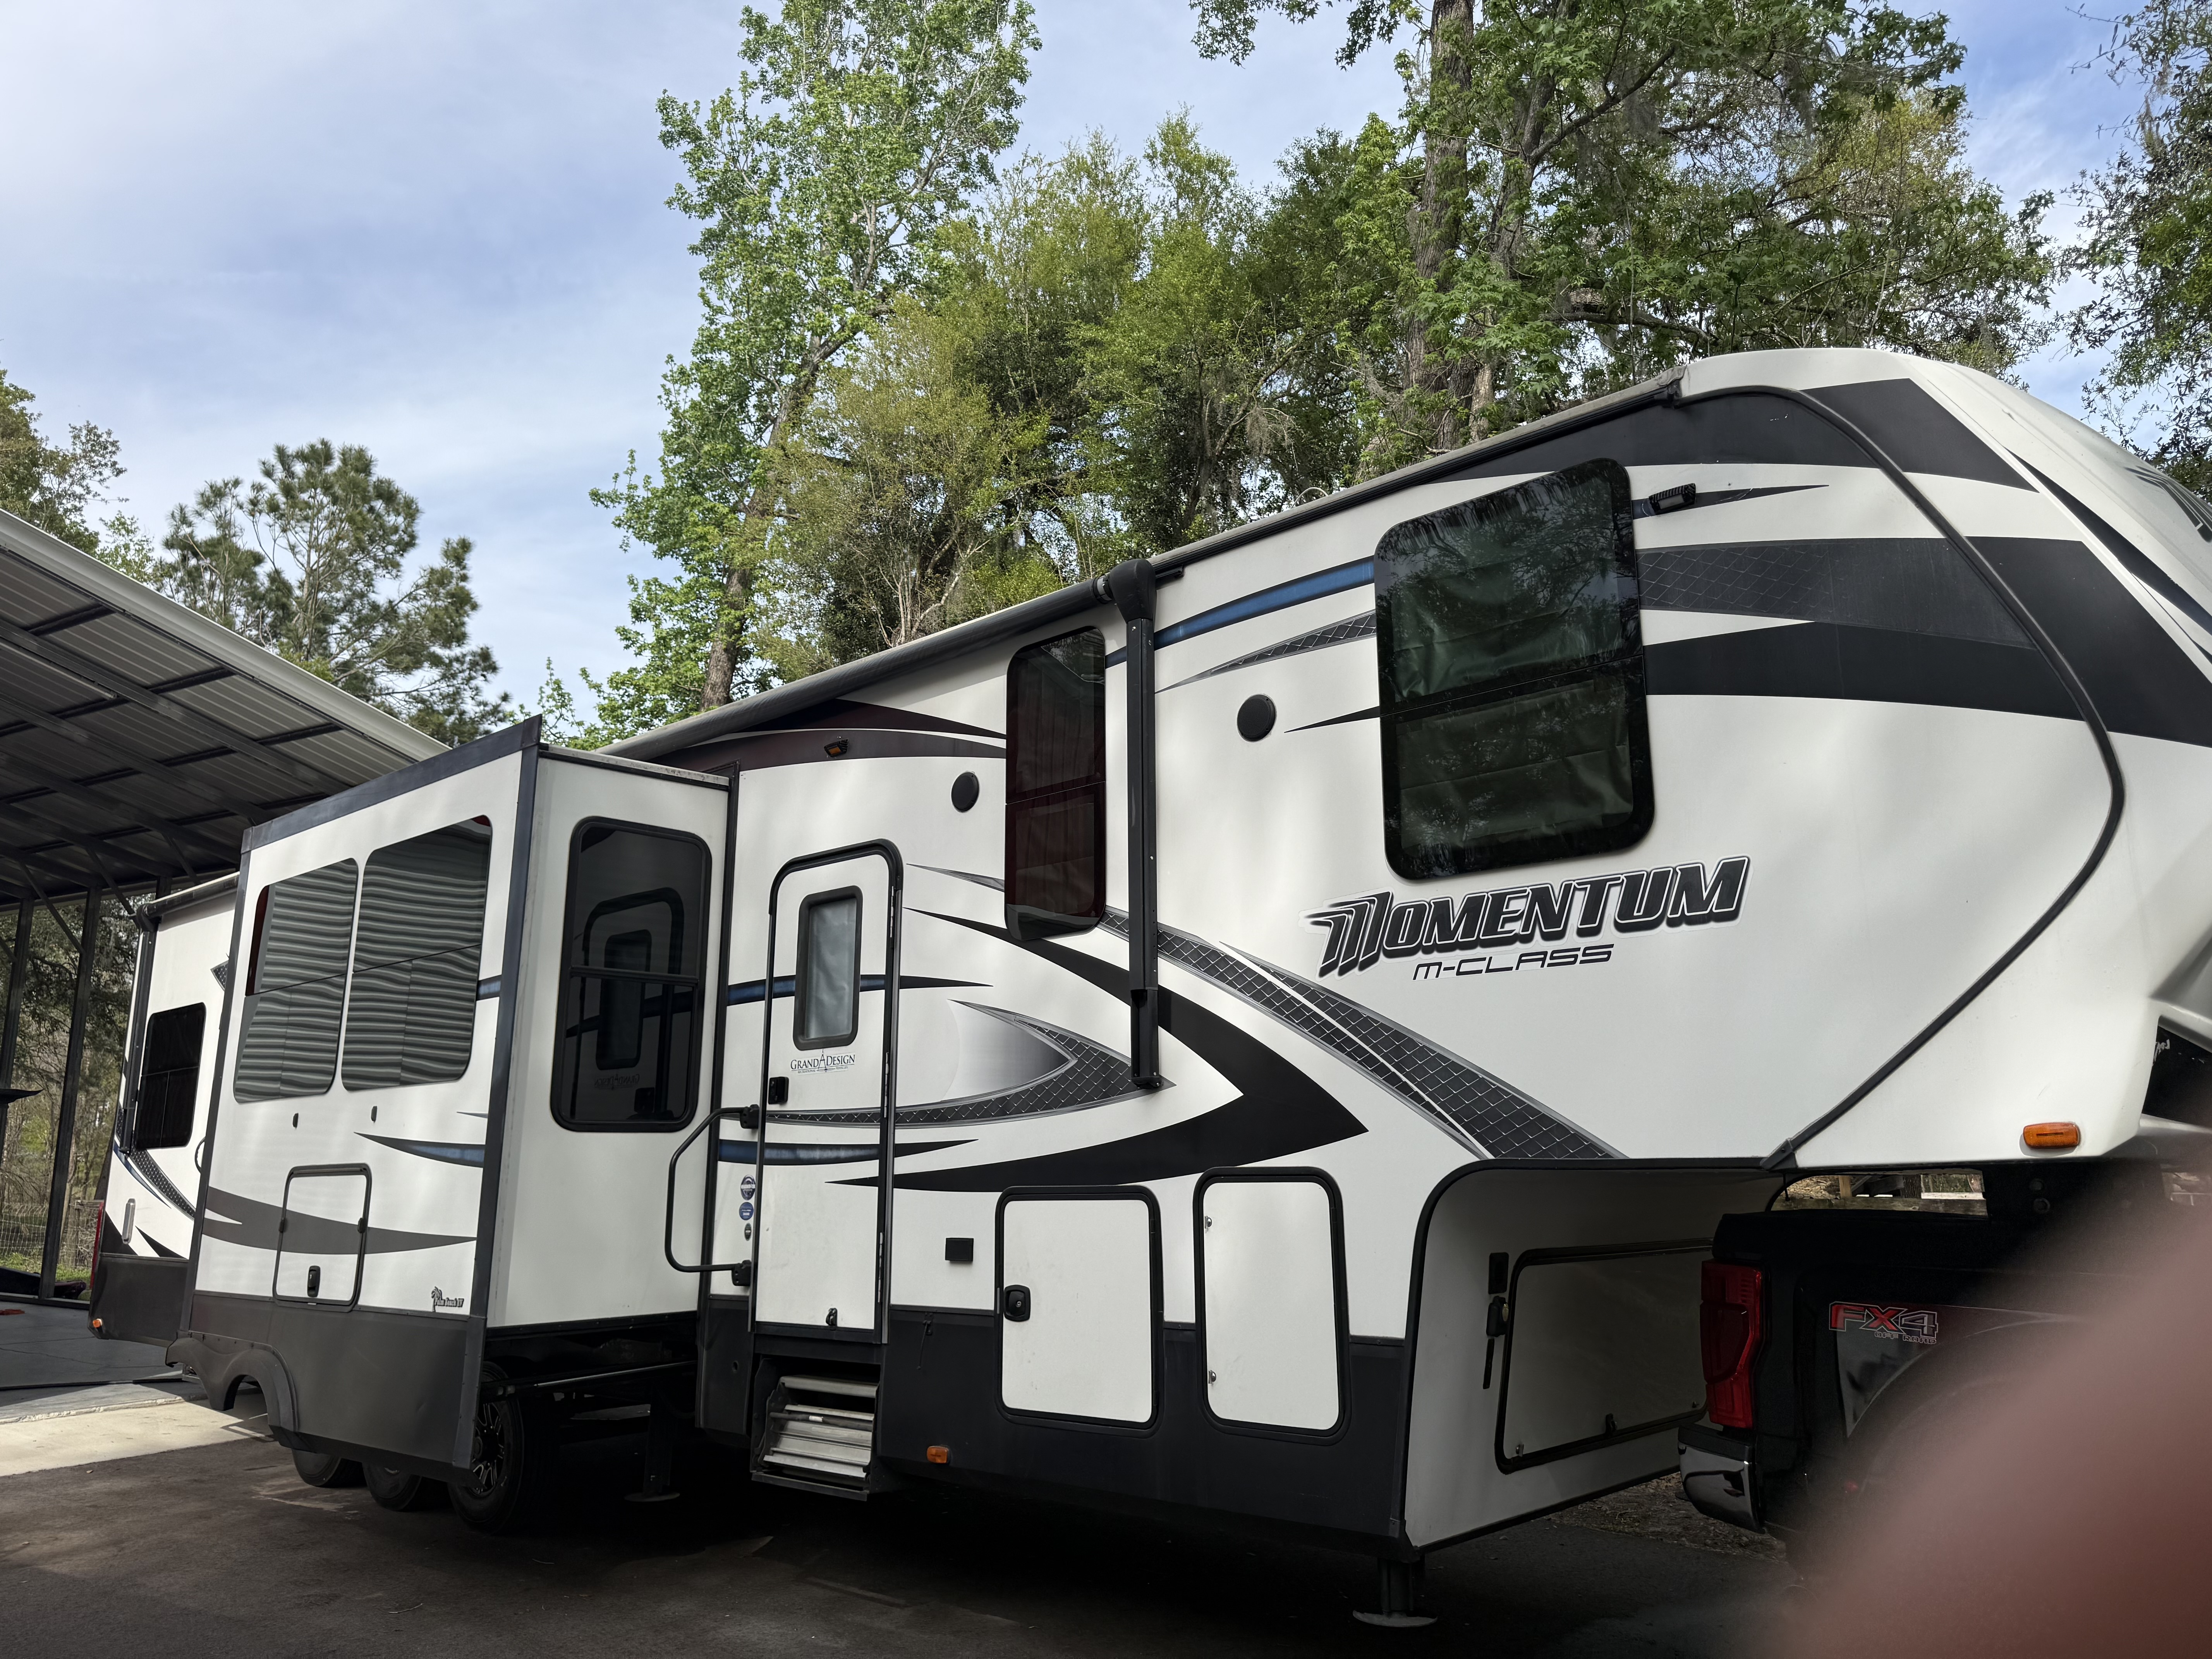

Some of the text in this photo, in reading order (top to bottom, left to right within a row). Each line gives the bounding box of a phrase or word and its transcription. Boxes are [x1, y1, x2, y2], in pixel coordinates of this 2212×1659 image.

[1304, 855, 1750, 977] MOMENTUM
[1413, 943, 1614, 981] M-CLASS
[790, 1054, 855, 1070] GRAND DESIGN
[1829, 1301, 1938, 1338] FX4
[1902, 1334, 1937, 1345] ROAD
